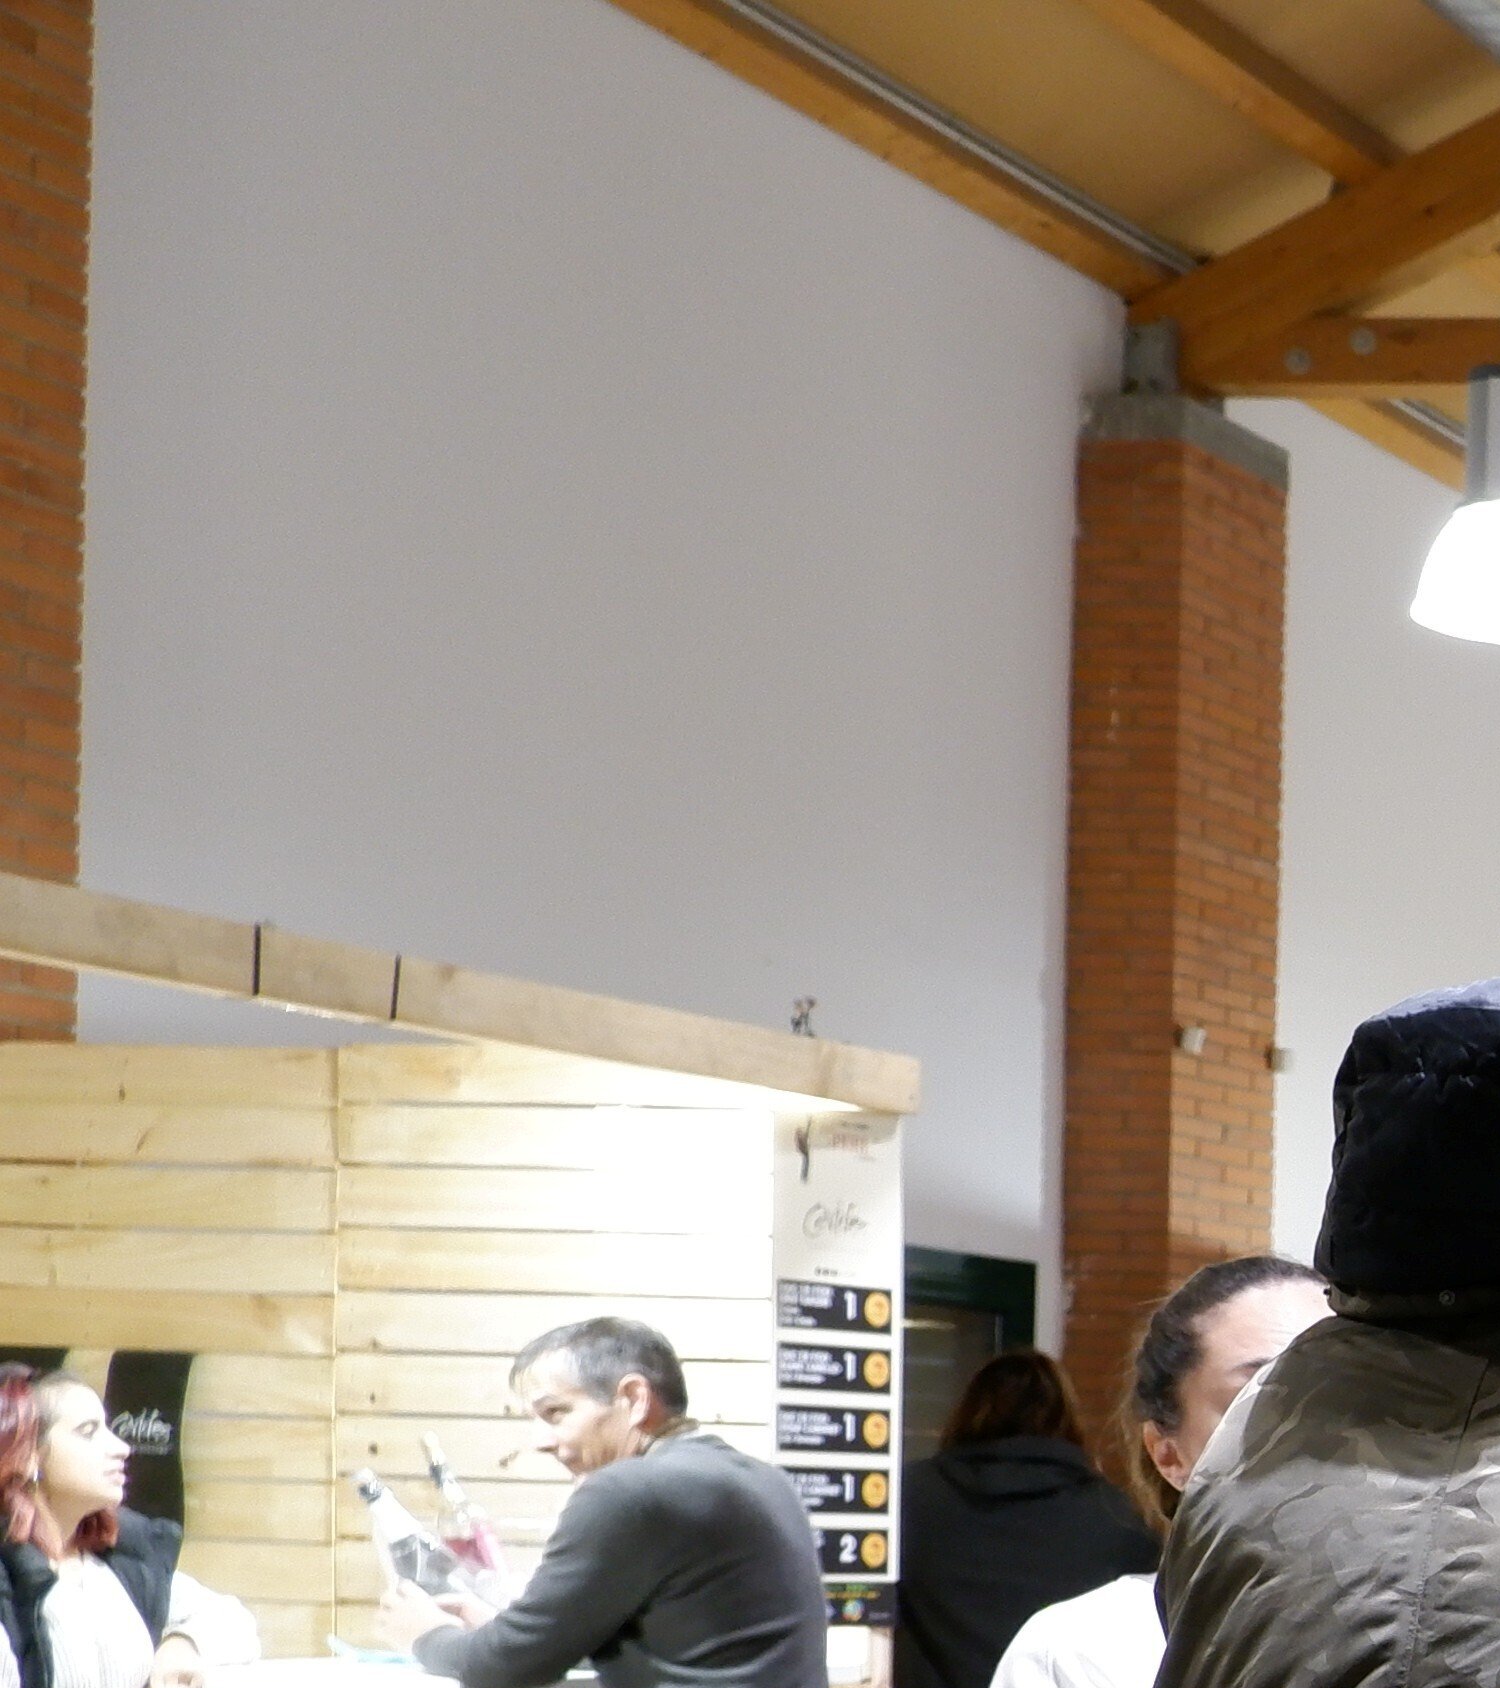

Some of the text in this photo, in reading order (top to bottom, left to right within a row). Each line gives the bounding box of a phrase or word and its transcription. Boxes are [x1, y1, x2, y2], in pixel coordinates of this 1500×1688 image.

[844, 1290, 857, 1321] 1
[843, 1351, 857, 1382] 1
[843, 1412, 857, 1442] 1
[842, 1472, 855, 1503] 1
[839, 1533, 858, 1564] 2
